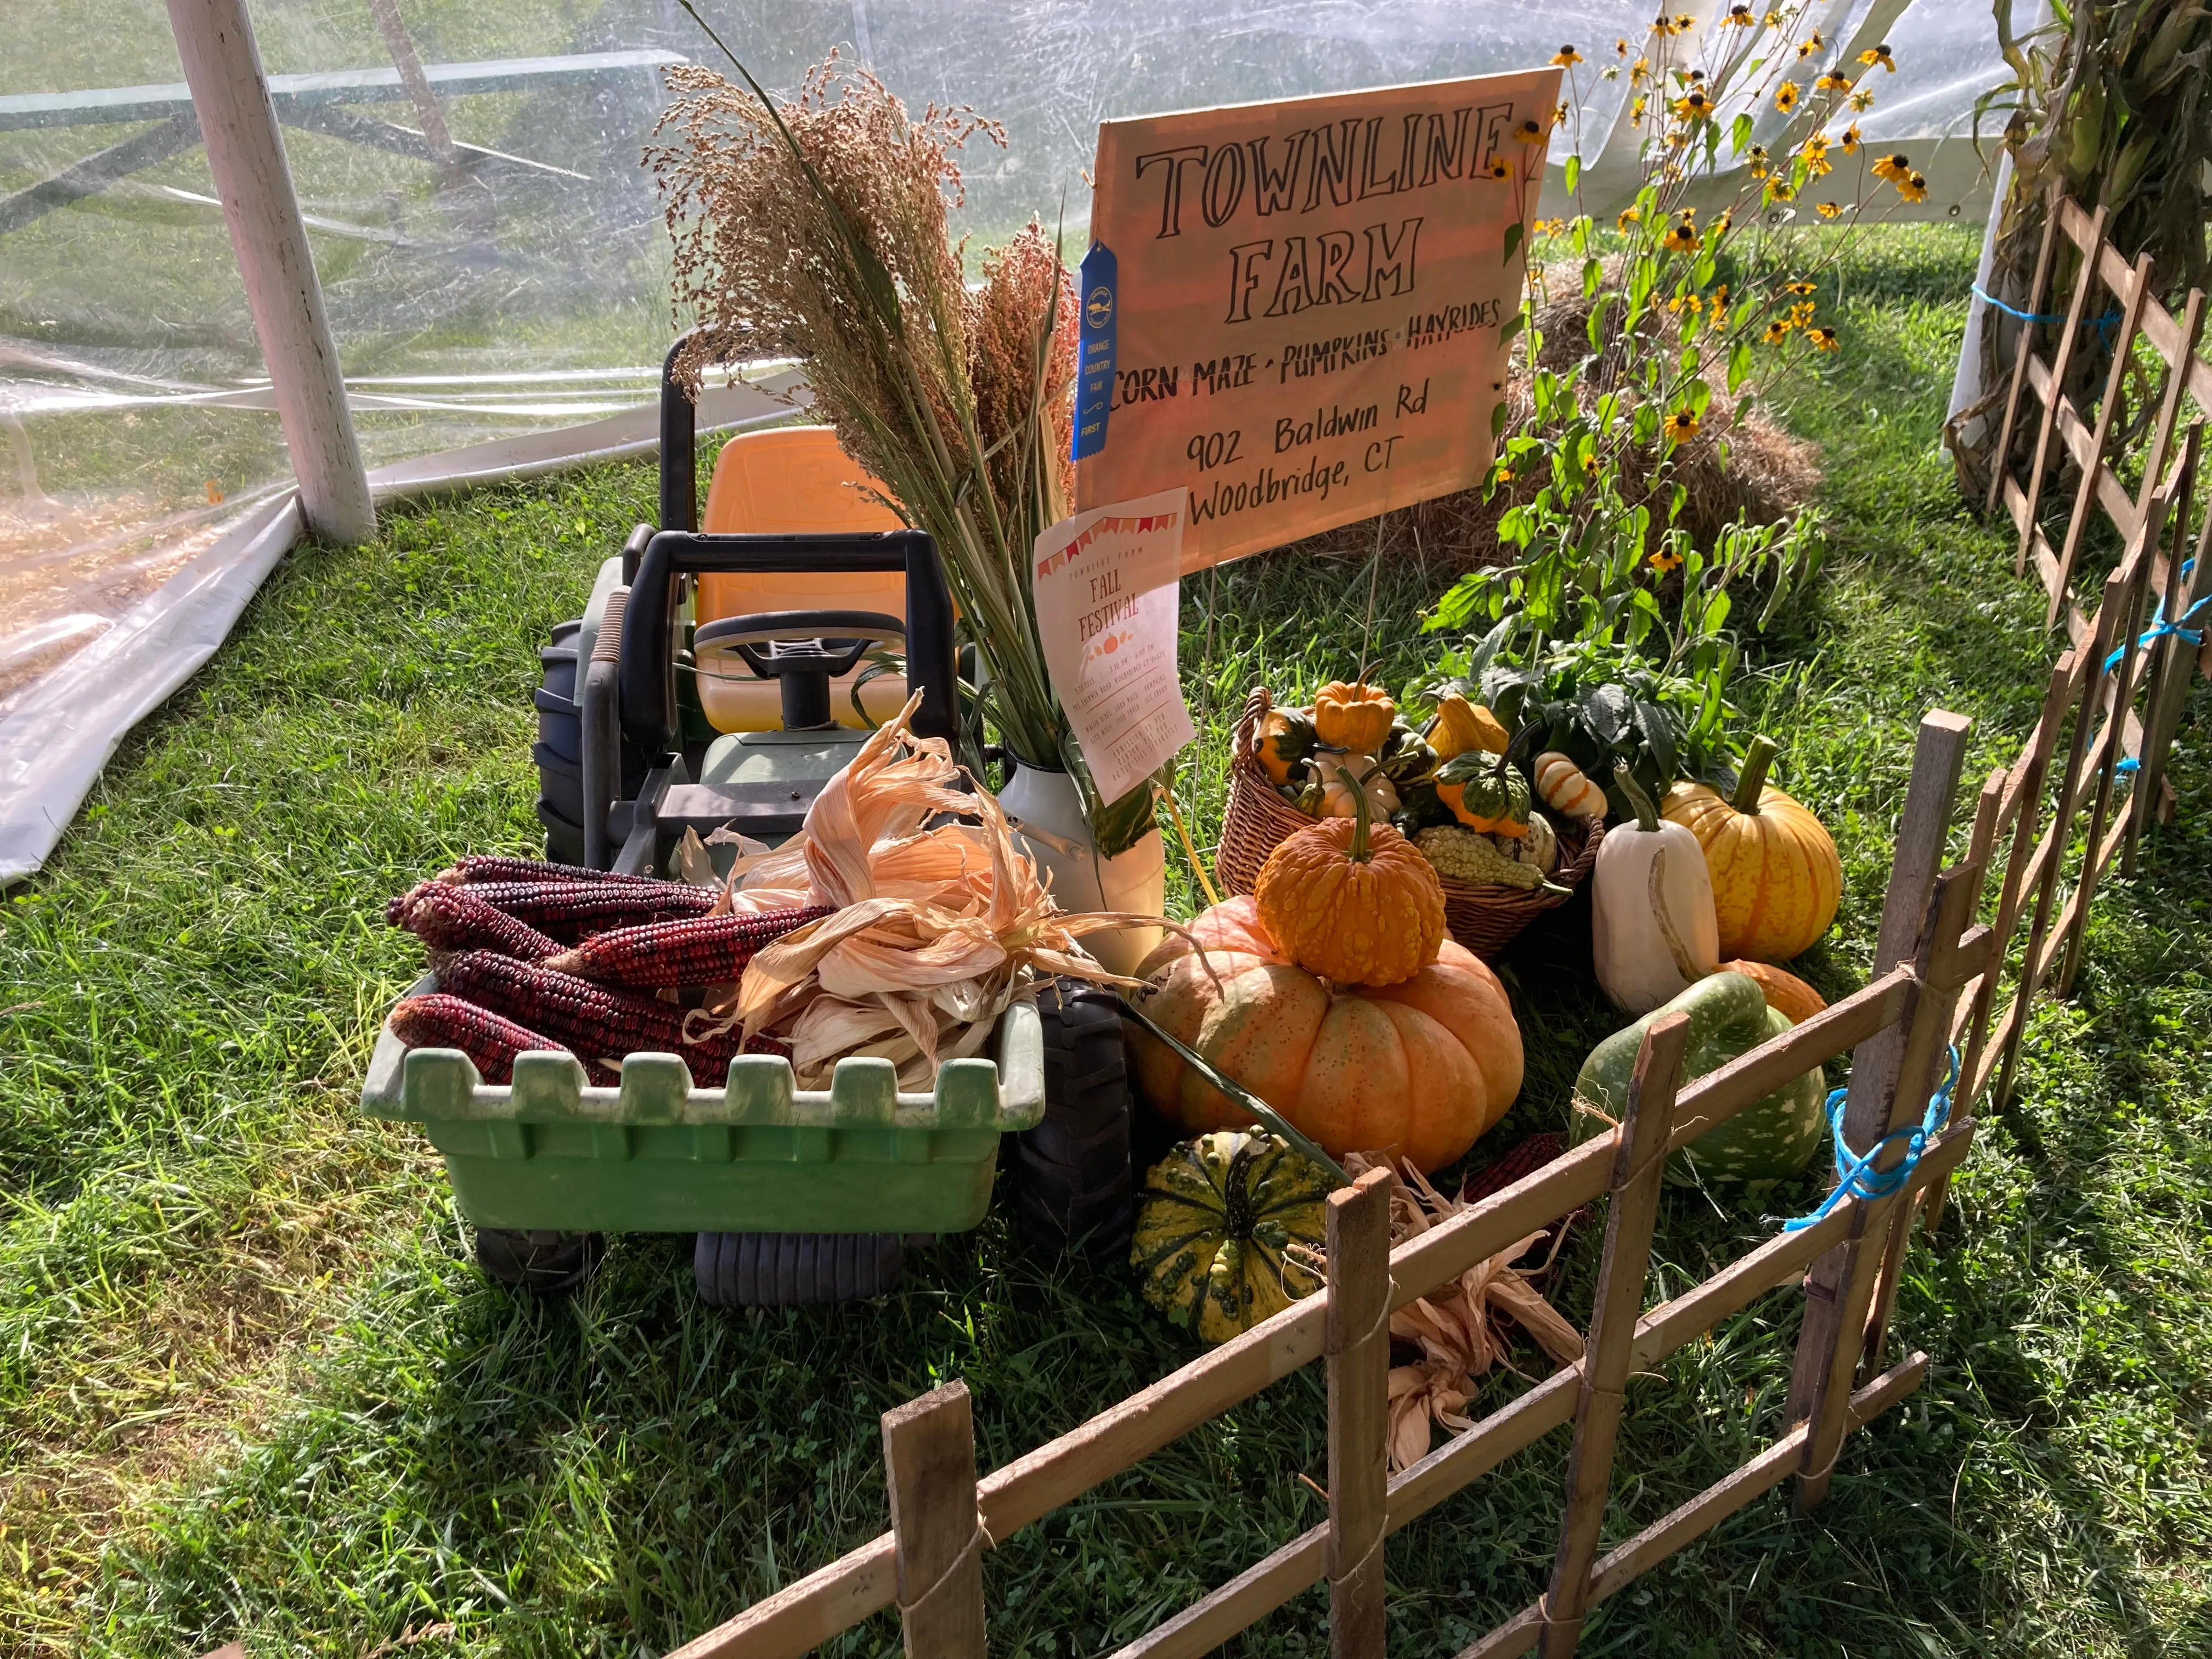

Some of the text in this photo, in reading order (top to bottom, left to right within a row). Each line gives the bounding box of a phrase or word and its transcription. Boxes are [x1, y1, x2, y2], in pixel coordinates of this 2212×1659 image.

[1136, 103, 1514, 239] TOWNLINE
[1224, 217, 1424, 325] FARM
[1085, 359, 1110, 375] COUNTRY
[1088, 339, 1110, 355] ORANGE
[1109, 298, 1501, 412] CORN MAZE PUMPKINS HAYRIDES
[1090, 381, 1103, 393] FAIR
[1081, 421, 1101, 437] FIRST
[1187, 379, 1430, 472] 902 Baldwin Rd
[1190, 435, 1404, 526] Woodbridge, CT
[1069, 546, 1143, 582] TOWNLINE FARM
[1089, 568, 1121, 603] FALL
[1077, 592, 1139, 641] FESTIVAL
[1099, 681, 1111, 694] ROAD
[1114, 663, 1142, 684] WOODBRIDGE
[1143, 658, 1149, 667] CT
[1085, 674, 1166, 733] WAGON RIDES CORN MAZE PUMPKINS
[1090, 732, 1101, 744] LIVE
[1101, 723, 1114, 736] MUSIC
[1115, 713, 1126, 725] FOOD
[1127, 703, 1140, 716] TRUCK
[1154, 684, 1168, 698] CREAM
[1113, 730, 1143, 758] ADMISSION
[1154, 713, 1165, 725] PER
[1156, 722, 1167, 735] FOR
[1112, 749, 1147, 781] ACTIVITIES
